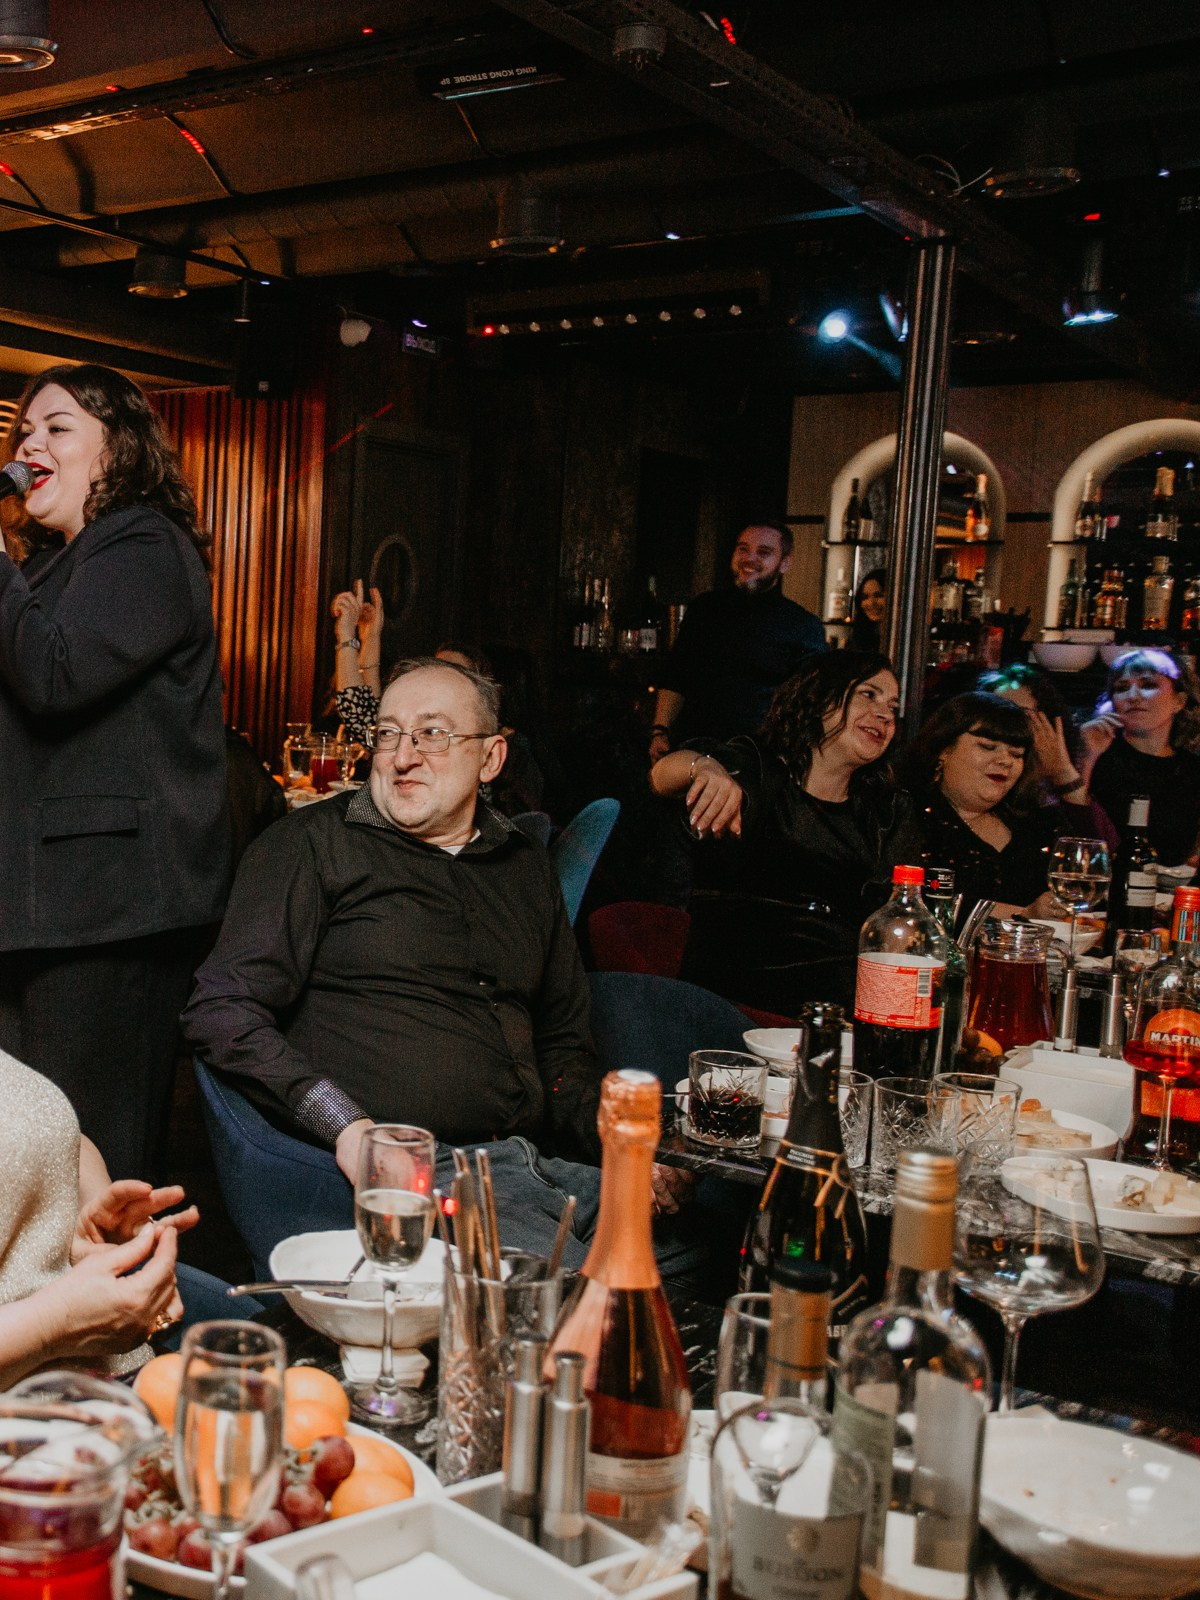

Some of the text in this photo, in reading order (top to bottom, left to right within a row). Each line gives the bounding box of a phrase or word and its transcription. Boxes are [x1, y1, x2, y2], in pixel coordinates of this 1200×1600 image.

[490, 69, 514, 79] KONG
[515, 66, 538, 75] KING
[454, 72, 488, 84] STROBE
